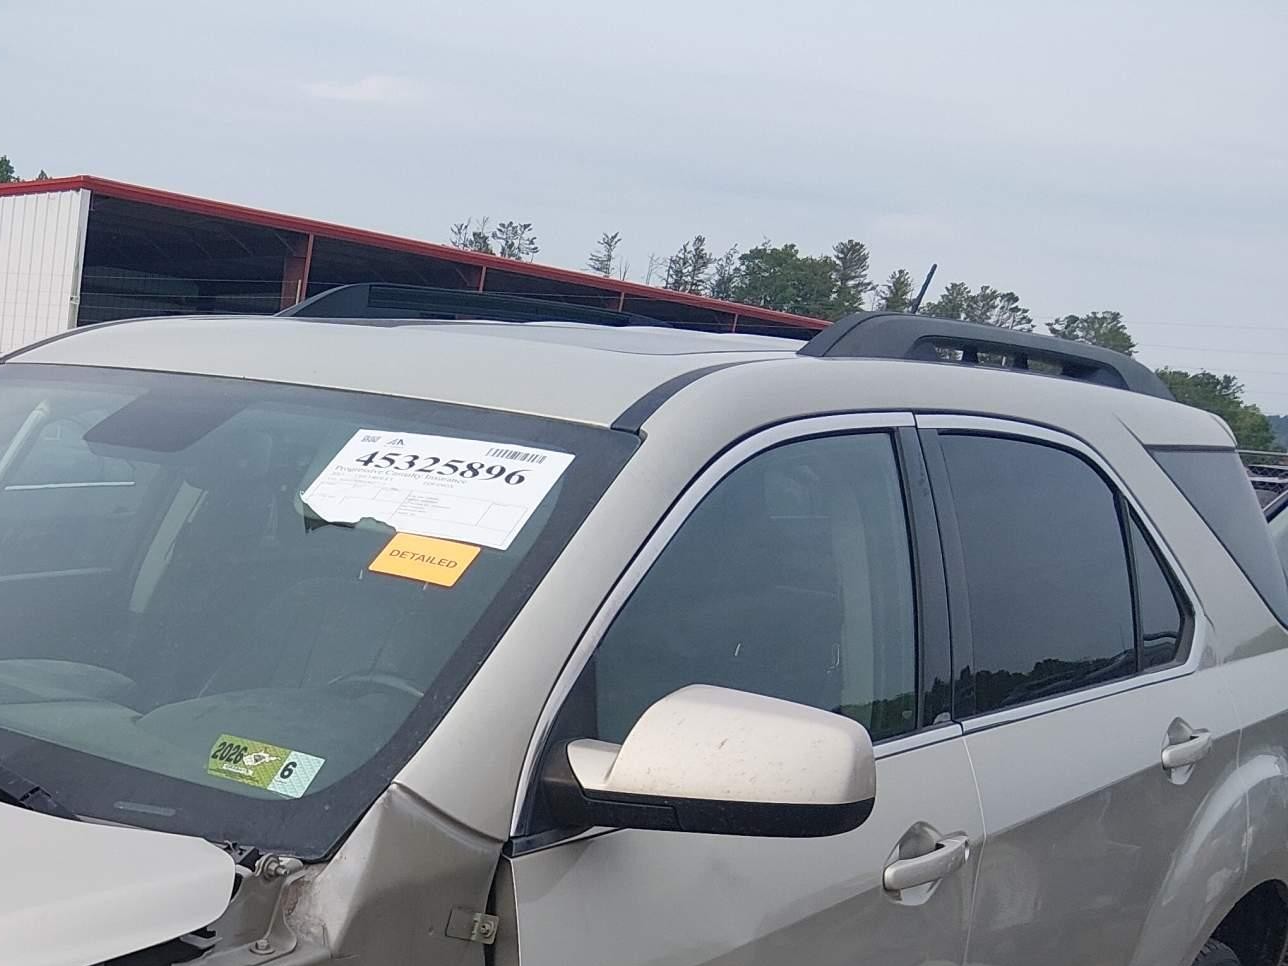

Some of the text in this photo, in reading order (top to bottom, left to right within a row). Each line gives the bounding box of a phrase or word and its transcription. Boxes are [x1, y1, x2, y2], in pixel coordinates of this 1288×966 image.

[355, 450, 534, 485] 45325896
[388, 548, 458, 569] DETAILED
[211, 741, 248, 764] 2026
[280, 761, 297, 779] 6
